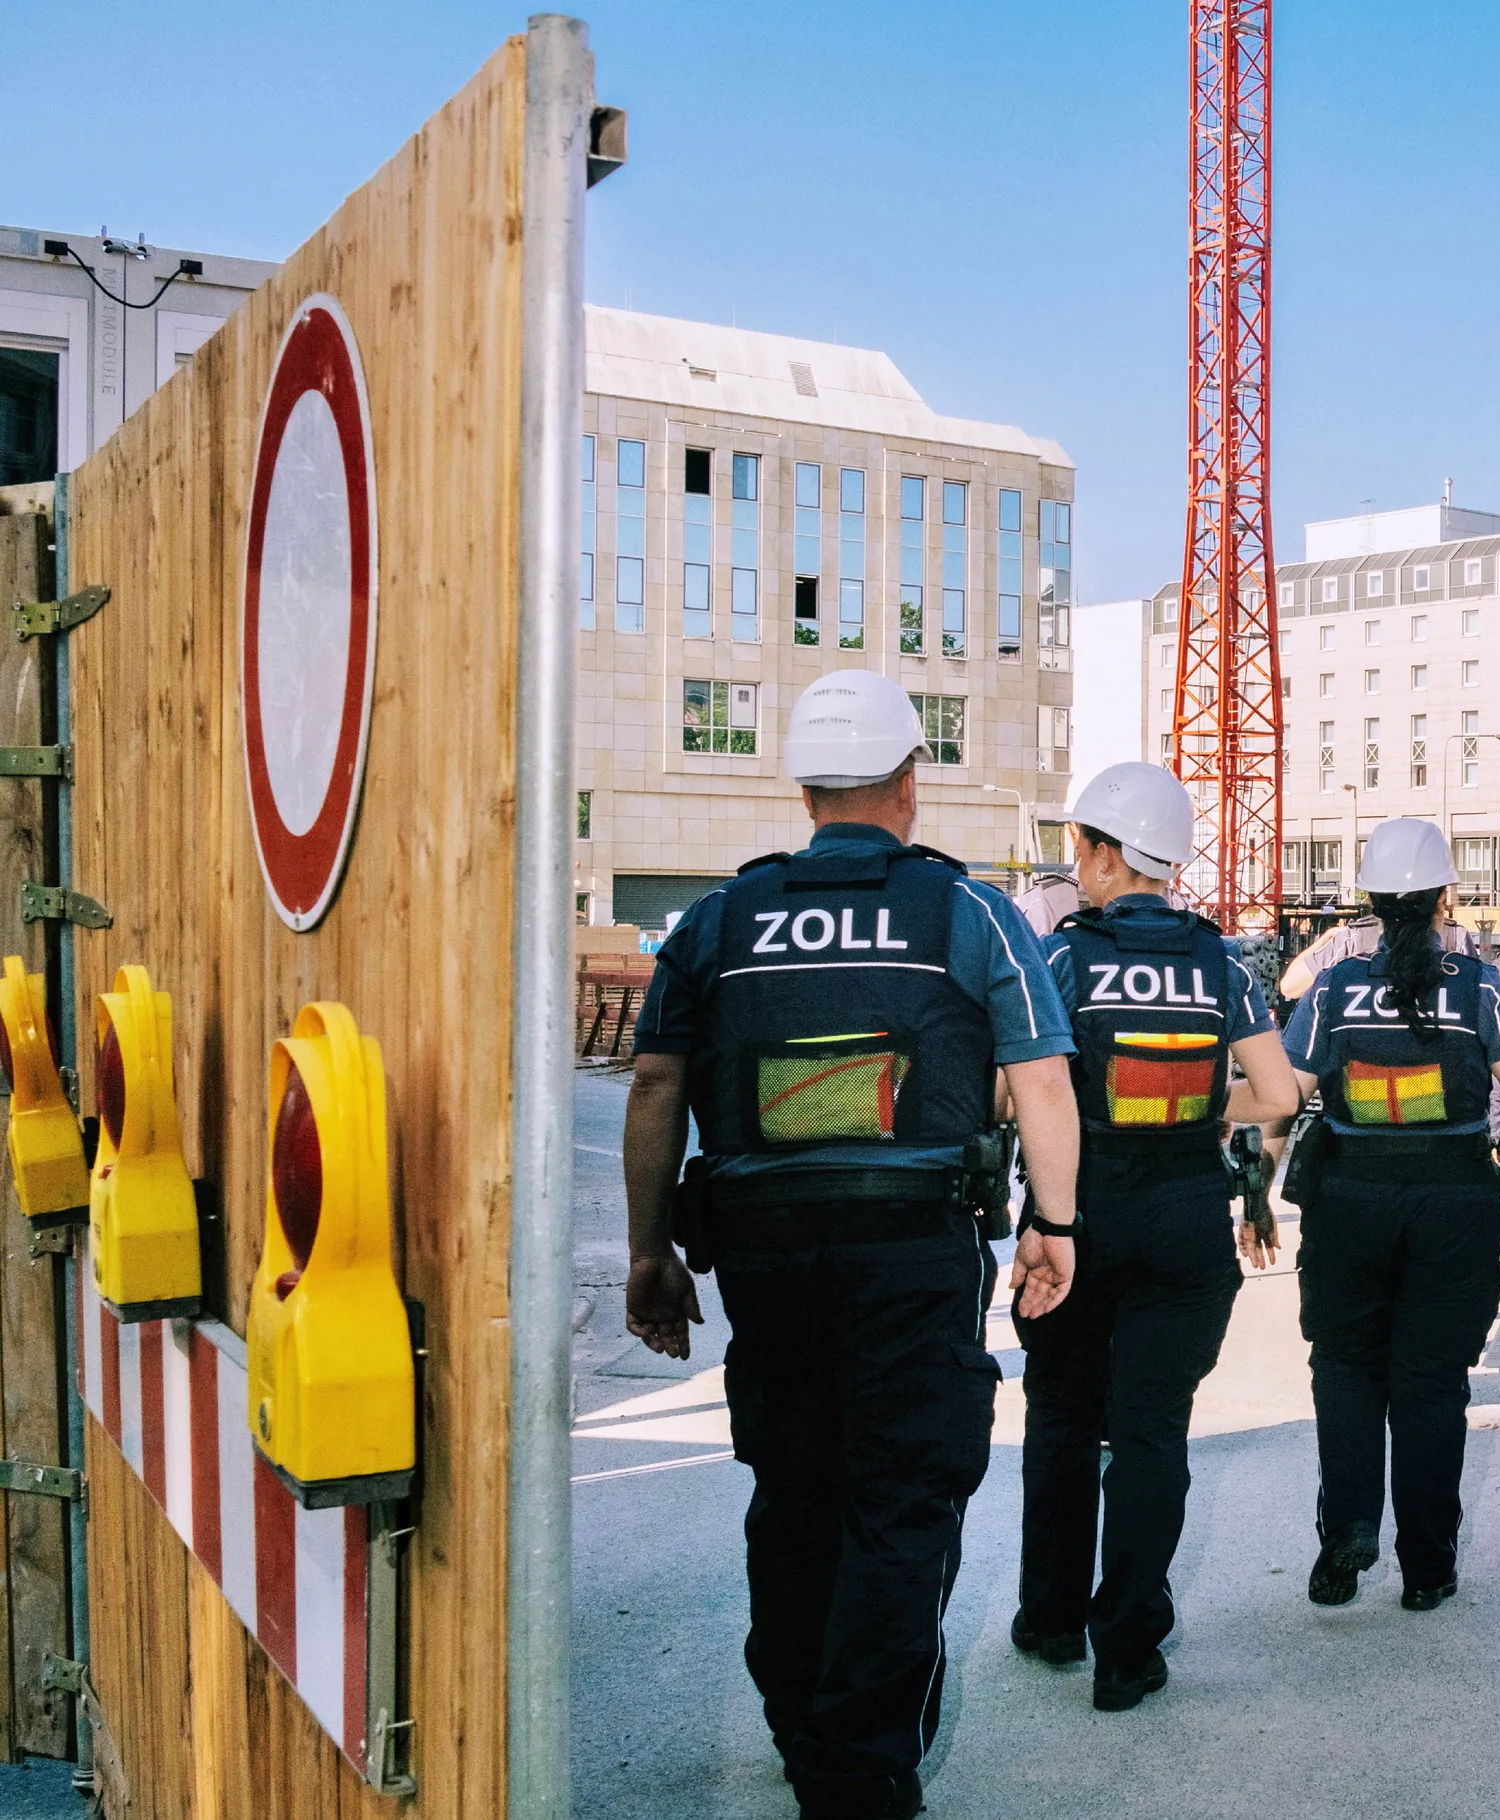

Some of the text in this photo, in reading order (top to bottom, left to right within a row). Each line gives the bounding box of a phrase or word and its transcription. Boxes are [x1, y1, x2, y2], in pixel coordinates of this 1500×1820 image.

[752, 908, 908, 954] ZOLL
[1089, 964, 1218, 1006] ZOLL
[1343, 985, 1461, 1020] ZOL
